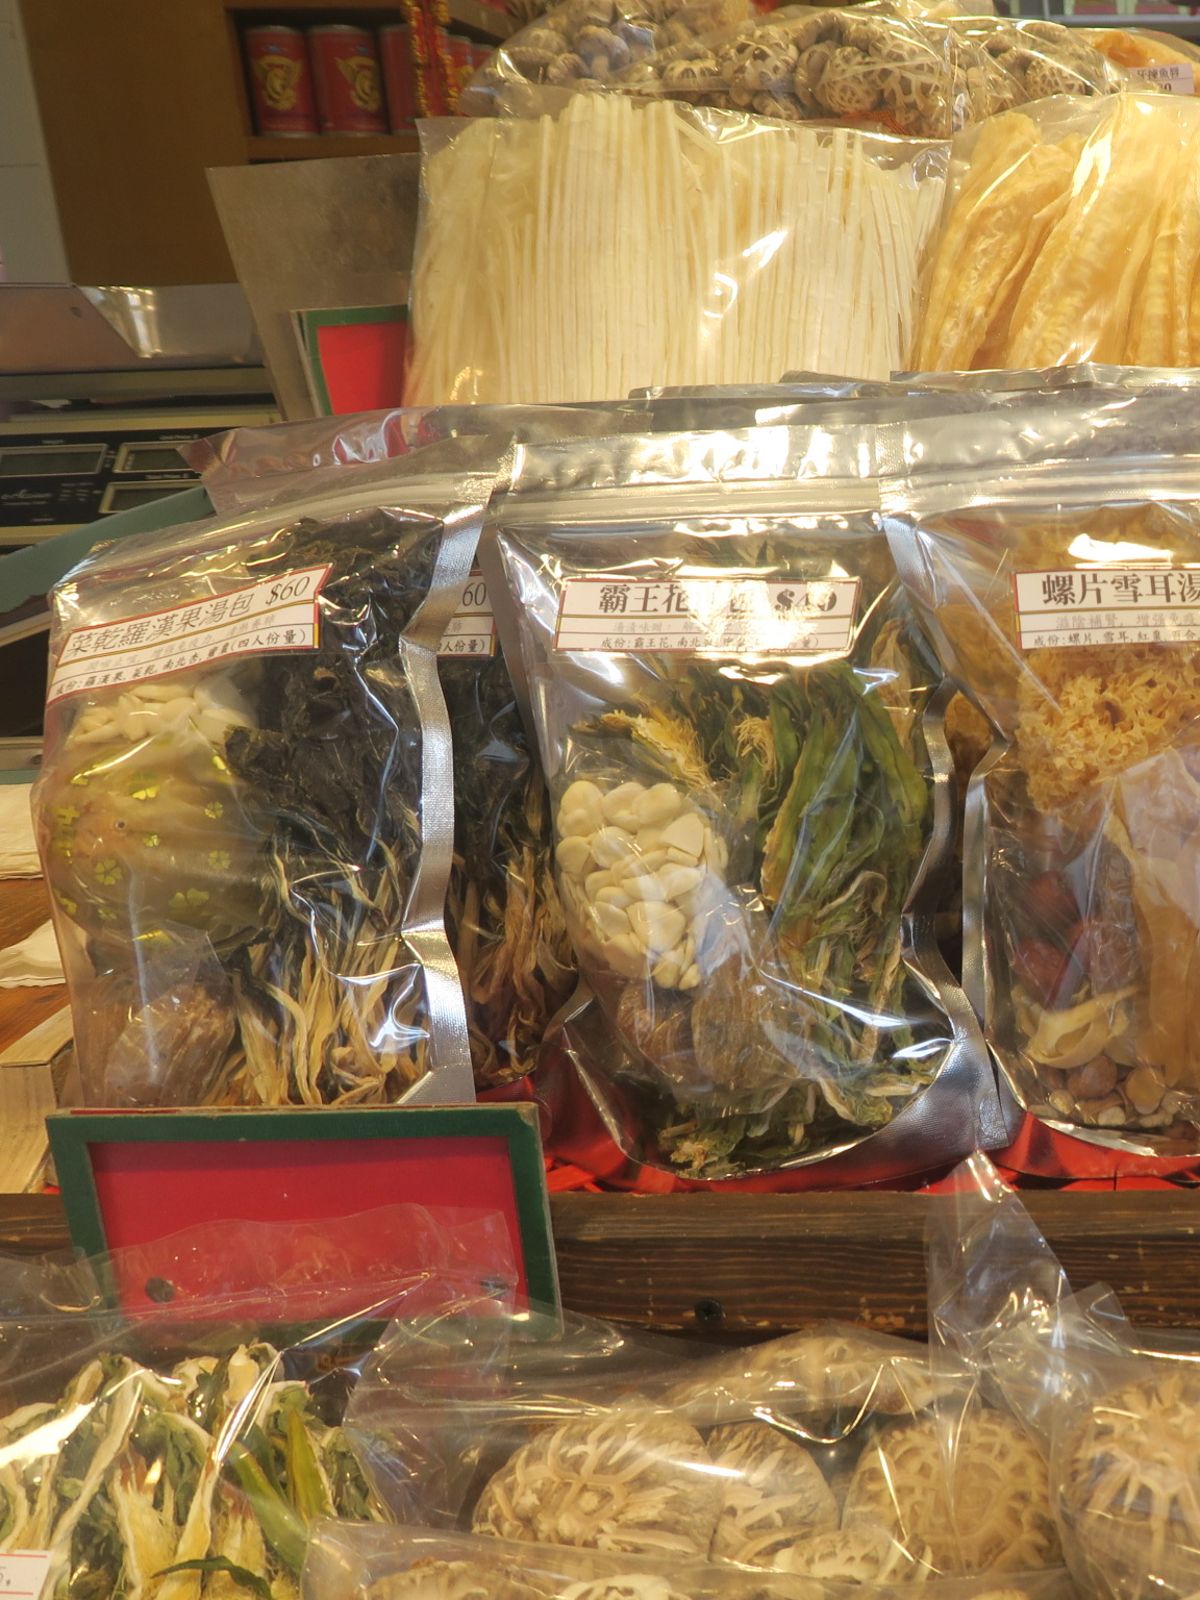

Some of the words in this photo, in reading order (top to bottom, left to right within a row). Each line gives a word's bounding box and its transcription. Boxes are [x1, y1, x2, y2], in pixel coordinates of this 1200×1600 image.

[67, 593, 254, 657] 菜乾羅漢果湯包
[264, 575, 312, 606] $60
